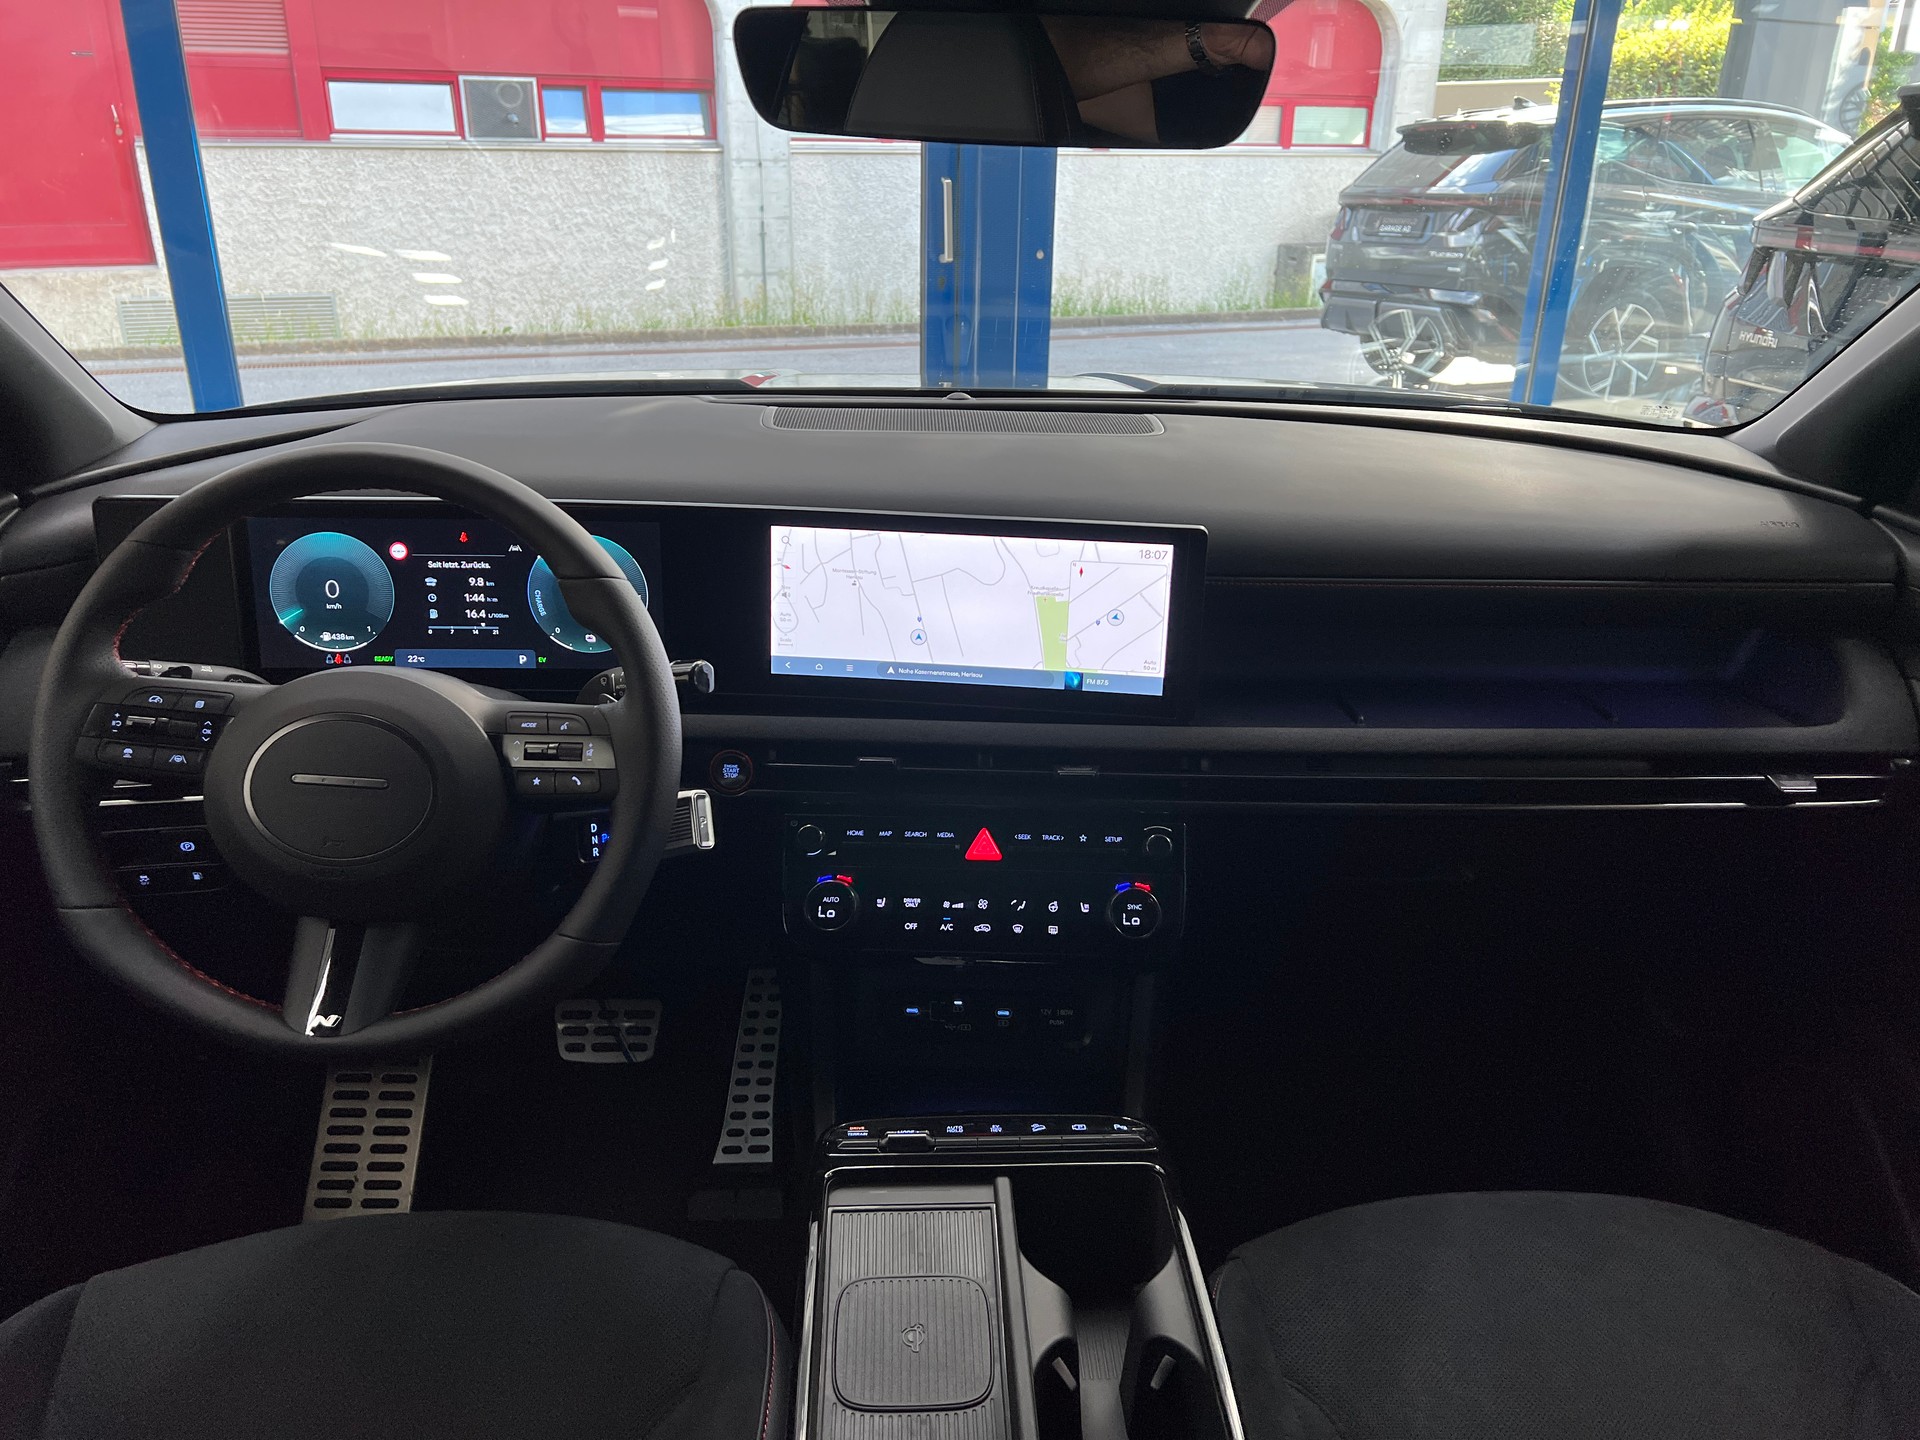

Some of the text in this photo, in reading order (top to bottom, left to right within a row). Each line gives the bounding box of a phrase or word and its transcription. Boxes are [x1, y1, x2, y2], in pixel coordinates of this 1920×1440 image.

[1739, 331, 1778, 348] HYUNDAI
[1139, 550, 1168, 560] 18:07
[468, 577, 484, 586] 9.8
[325, 580, 339, 598] 0
[464, 593, 485, 602] 1:44
[534, 589, 546, 616] CHARGE
[465, 609, 486, 618] 16.4
[519, 655, 527, 664] P
[590, 824, 597, 832] D
[593, 848, 599, 856] R
